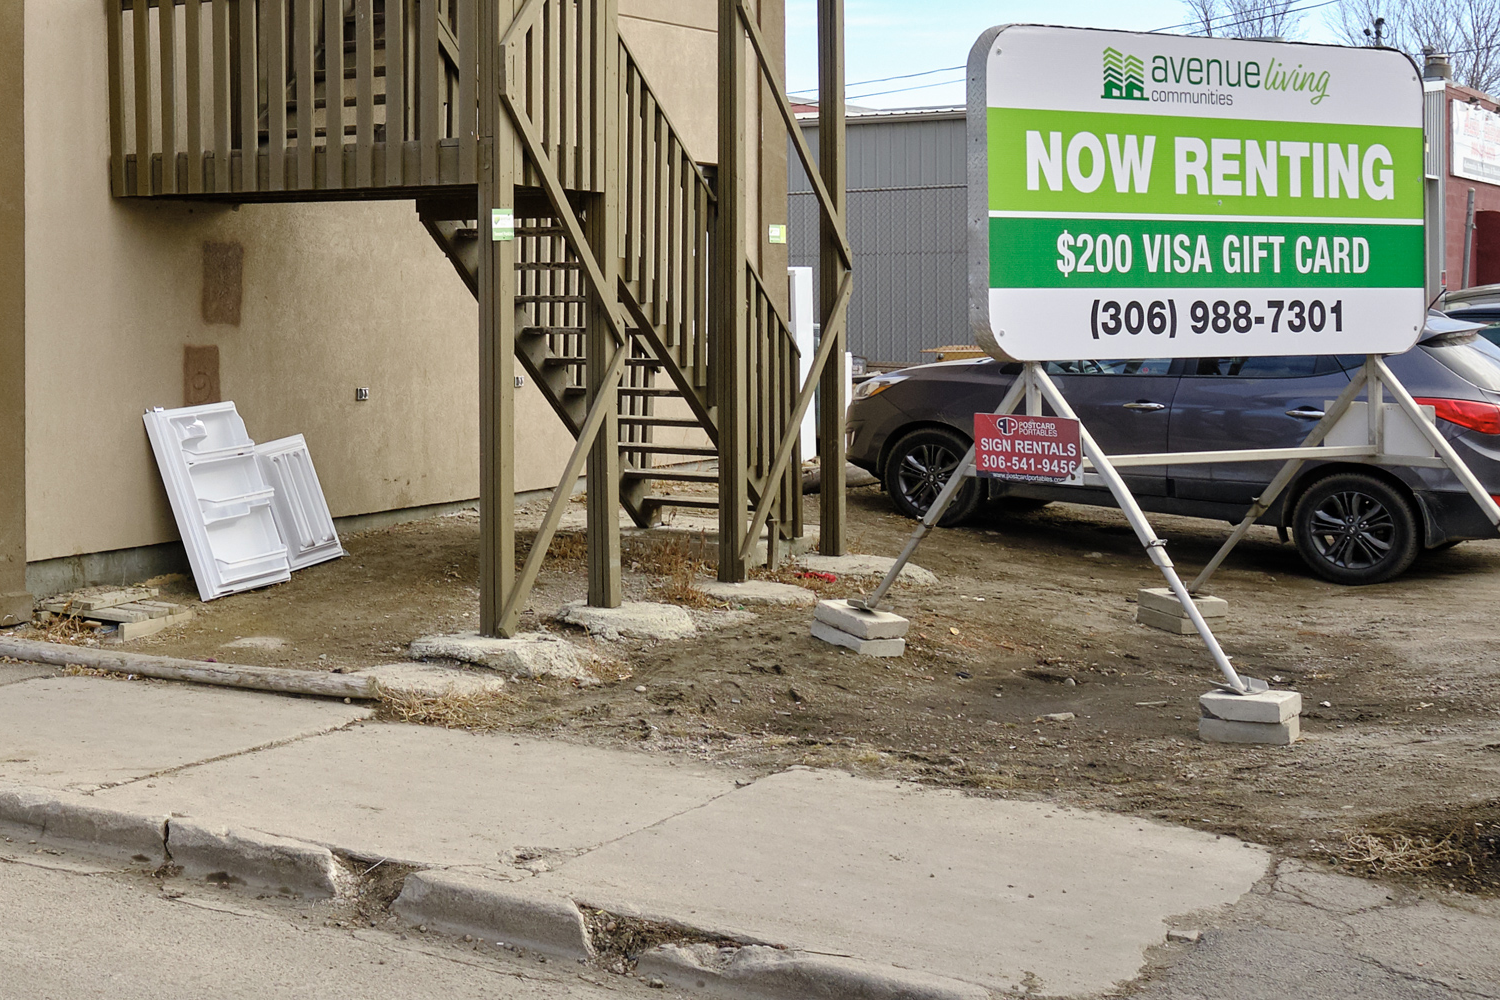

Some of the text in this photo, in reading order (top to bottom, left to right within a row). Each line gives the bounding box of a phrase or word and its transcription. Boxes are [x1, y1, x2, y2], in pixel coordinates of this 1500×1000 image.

[1151, 54, 1331, 106] avenue living
[1151, 89, 1234, 107] communities
[1025, 129, 1395, 201] NOW RENTING
[1056, 229, 1370, 278] $200 VISA GIFT CARD
[1090, 298, 1343, 339] (306) 988-7301
[1019, 421, 1056, 430] POSTCARD
[1019, 428, 1058, 438] PORTABLES
[980, 437, 1077, 457] SIGN RENTALS
[982, 454, 1077, 474] 306-541-9456
